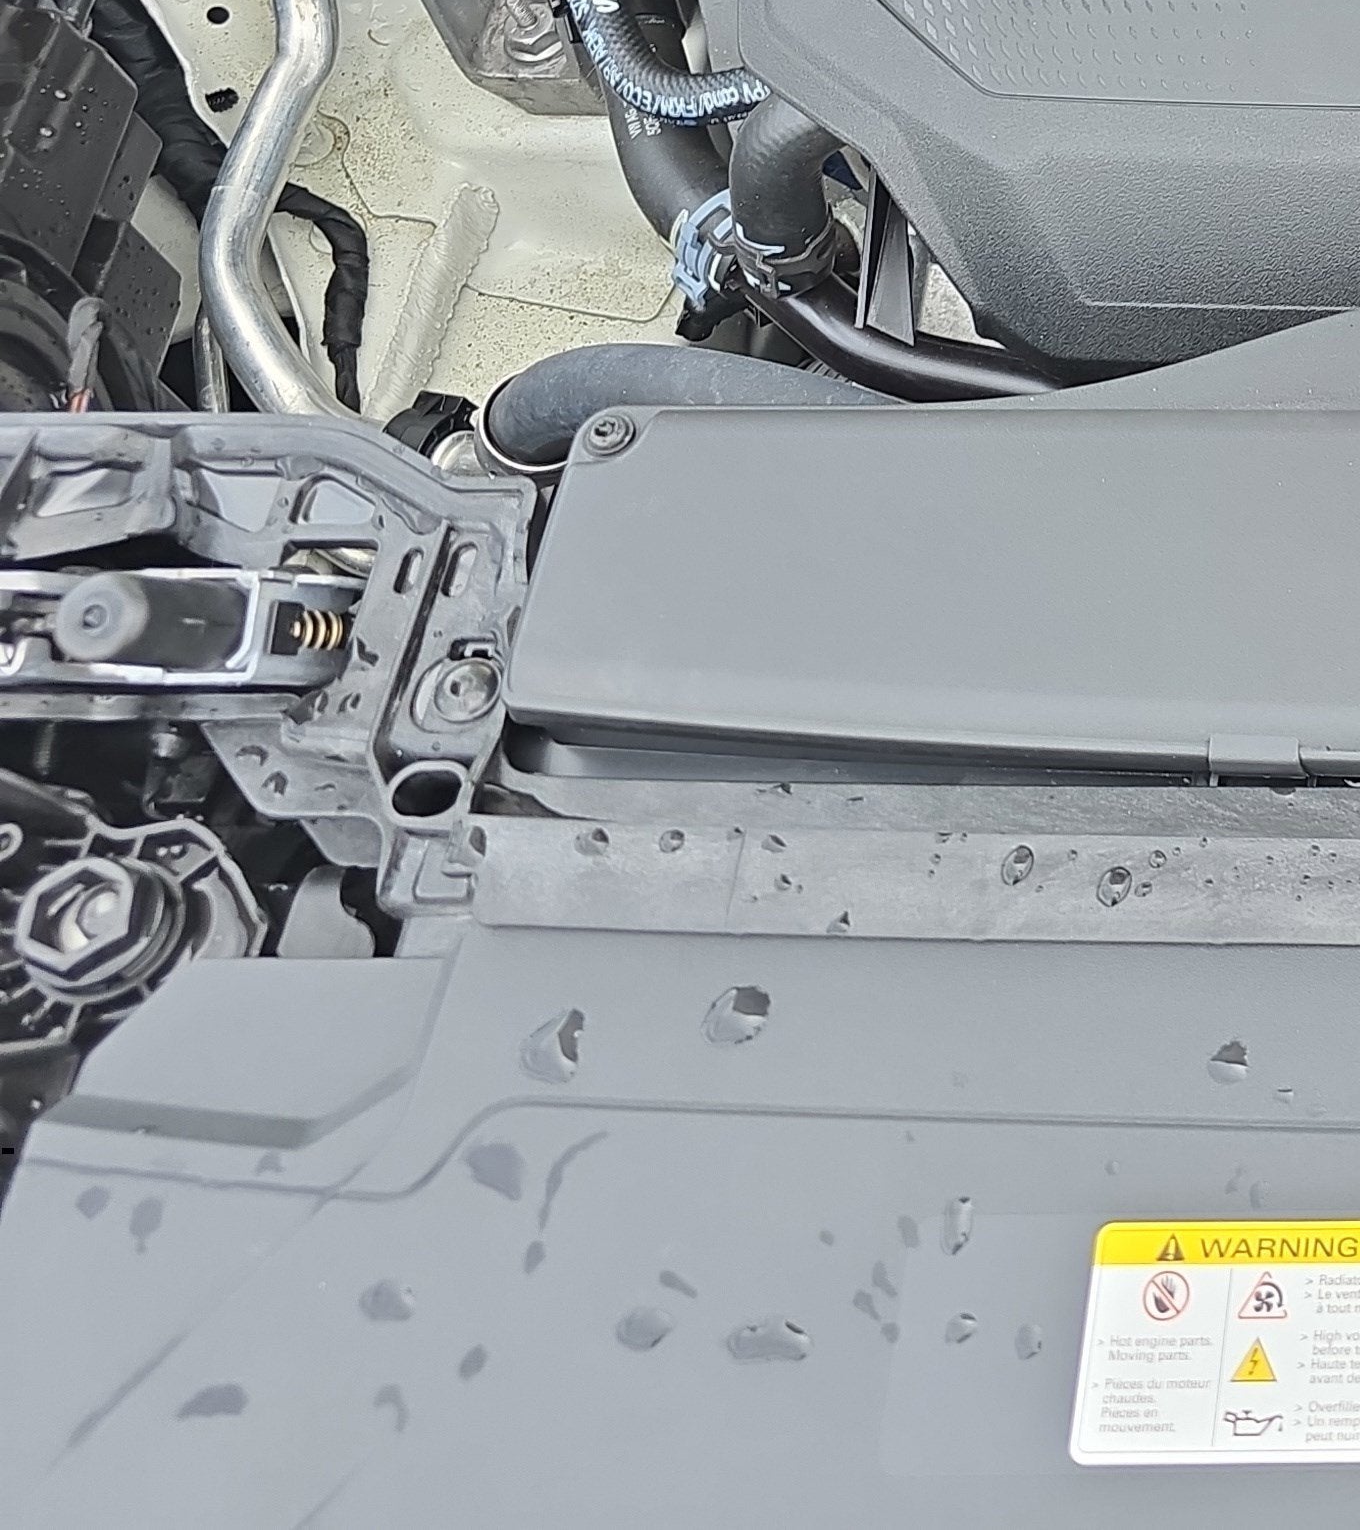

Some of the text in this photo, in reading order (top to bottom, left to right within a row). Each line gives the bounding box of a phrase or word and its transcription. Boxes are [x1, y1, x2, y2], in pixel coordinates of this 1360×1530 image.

[1200, 1235, 1359, 1259] WARNING
[1317, 1288, 1332, 1300] Le
[1327, 1302, 1351, 1313] tout
[1313, 1329, 1342, 1343] High
[1110, 1336, 1132, 1346] Hot
[1135, 1337, 1177, 1349] engine
[1312, 1344, 1351, 1355] before
[1108, 1350, 1154, 1363] Moving
[1310, 1358, 1345, 1369] Haute
[1147, 1378, 1162, 1389] du
[1166, 1379, 1211, 1389] moteur
[1309, 1373, 1343, 1384] avant
[1346, 1372, 1360, 1383] de
[1143, 1409, 1158, 1418] en
[1307, 1416, 1325, 1426] Un
[1305, 1430, 1334, 1444] peut
